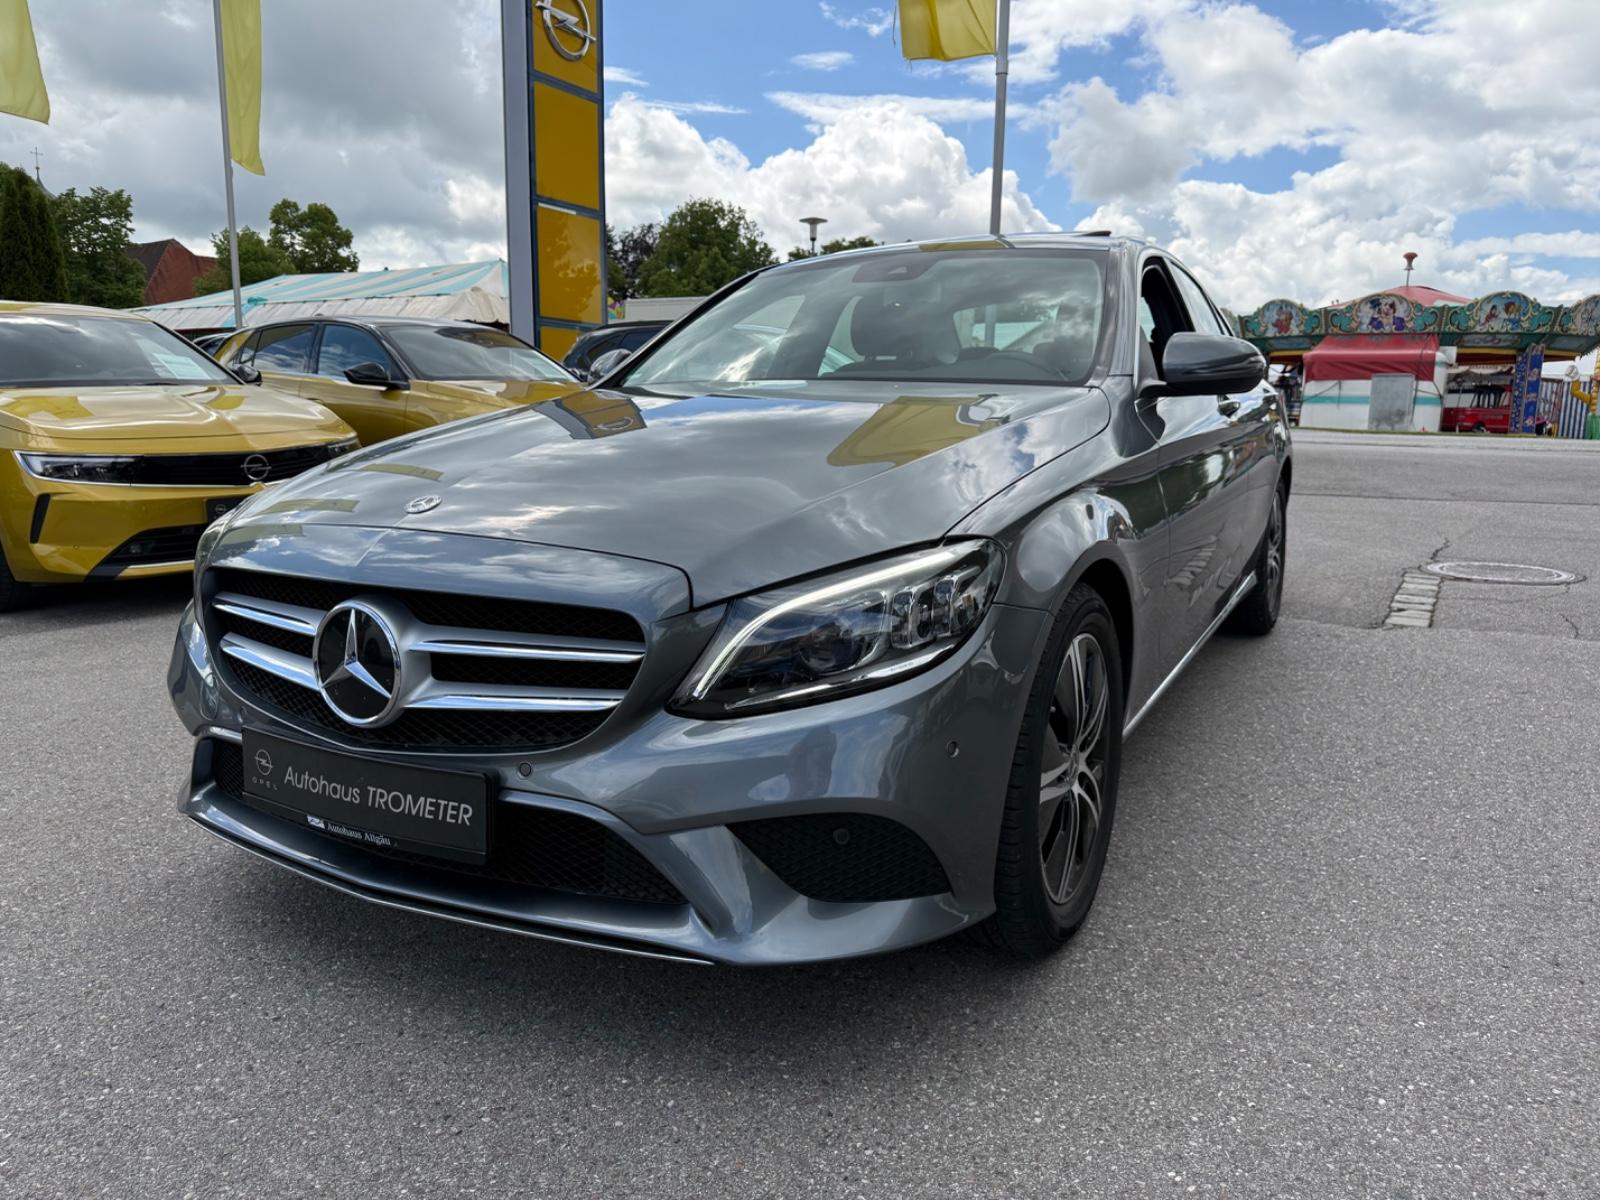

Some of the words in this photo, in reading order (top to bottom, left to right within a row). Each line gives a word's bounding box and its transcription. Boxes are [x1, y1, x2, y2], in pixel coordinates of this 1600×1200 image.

[284, 766, 361, 804] Autohaus
[367, 786, 473, 826] TROMETER
[327, 822, 363, 840] Autohaus
